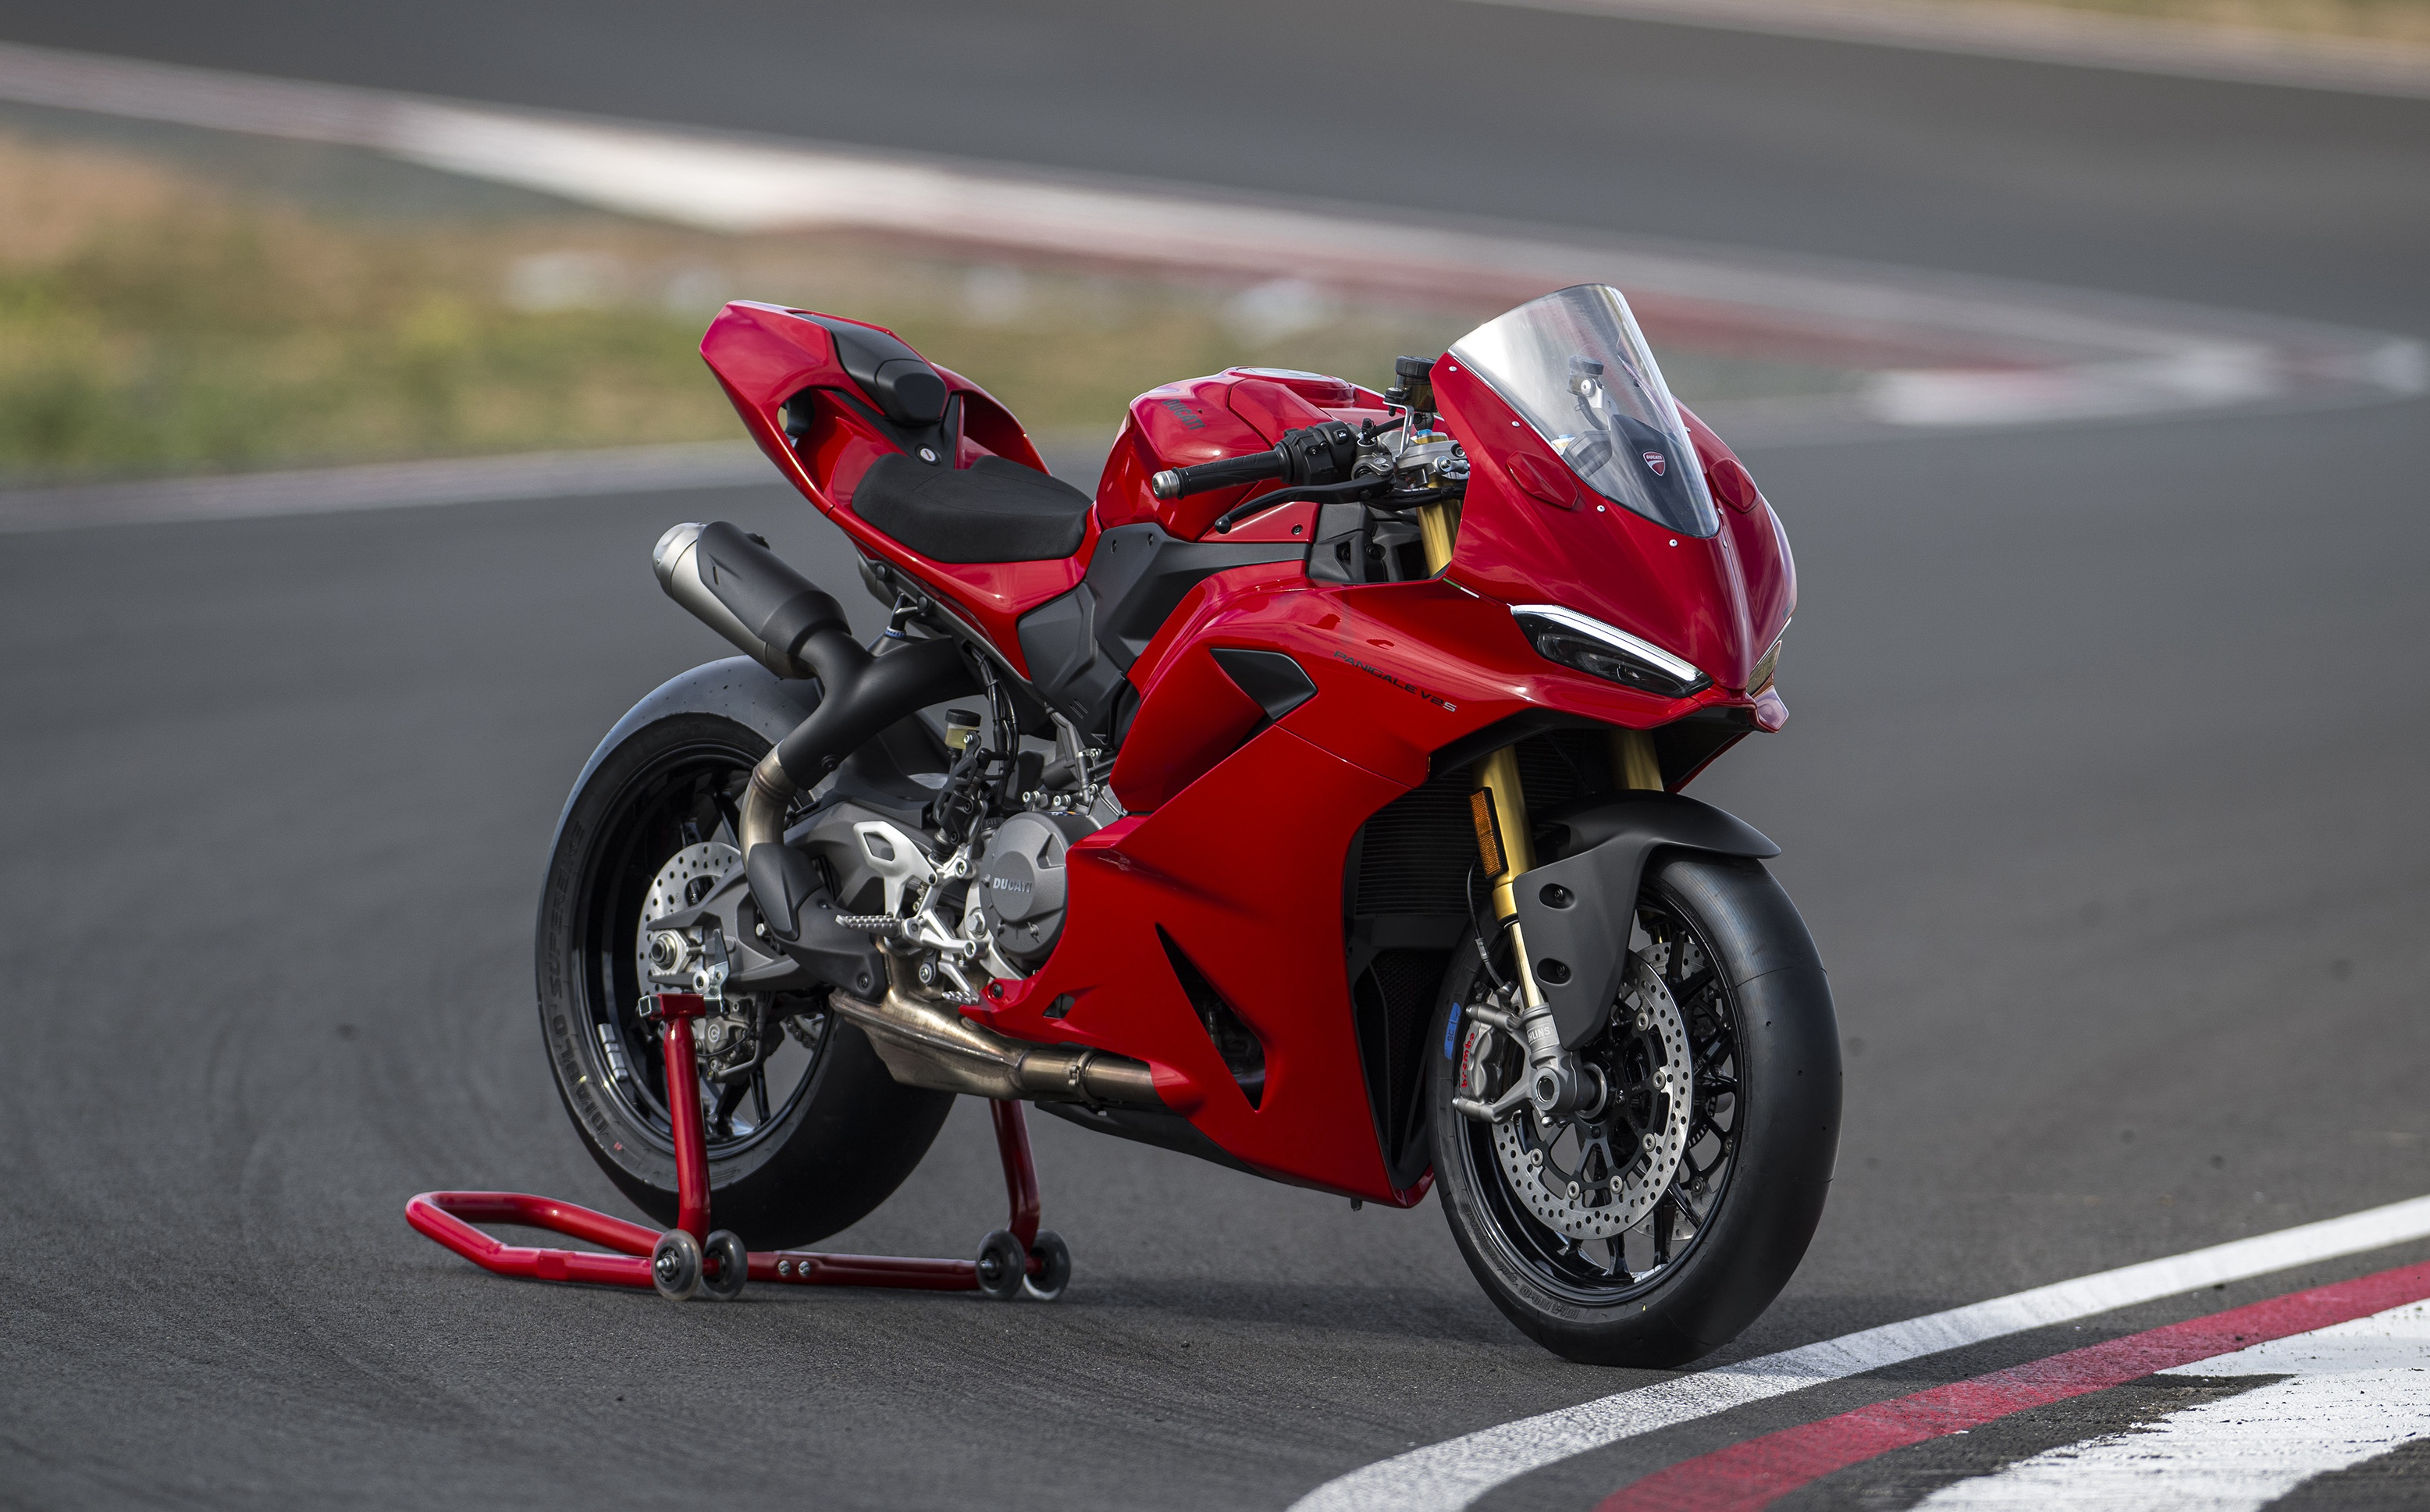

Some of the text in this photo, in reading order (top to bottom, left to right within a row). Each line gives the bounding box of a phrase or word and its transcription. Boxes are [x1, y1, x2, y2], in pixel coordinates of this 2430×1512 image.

[1162, 399, 1206, 430] DUCATI
[1333, 650, 1418, 695] PANIGALE
[993, 877, 1033, 893] DUCATI
[553, 1014, 609, 1135] DIABLO
[1461, 1033, 1475, 1088] brembo
[1519, 1284, 1579, 1319] DIABLO
